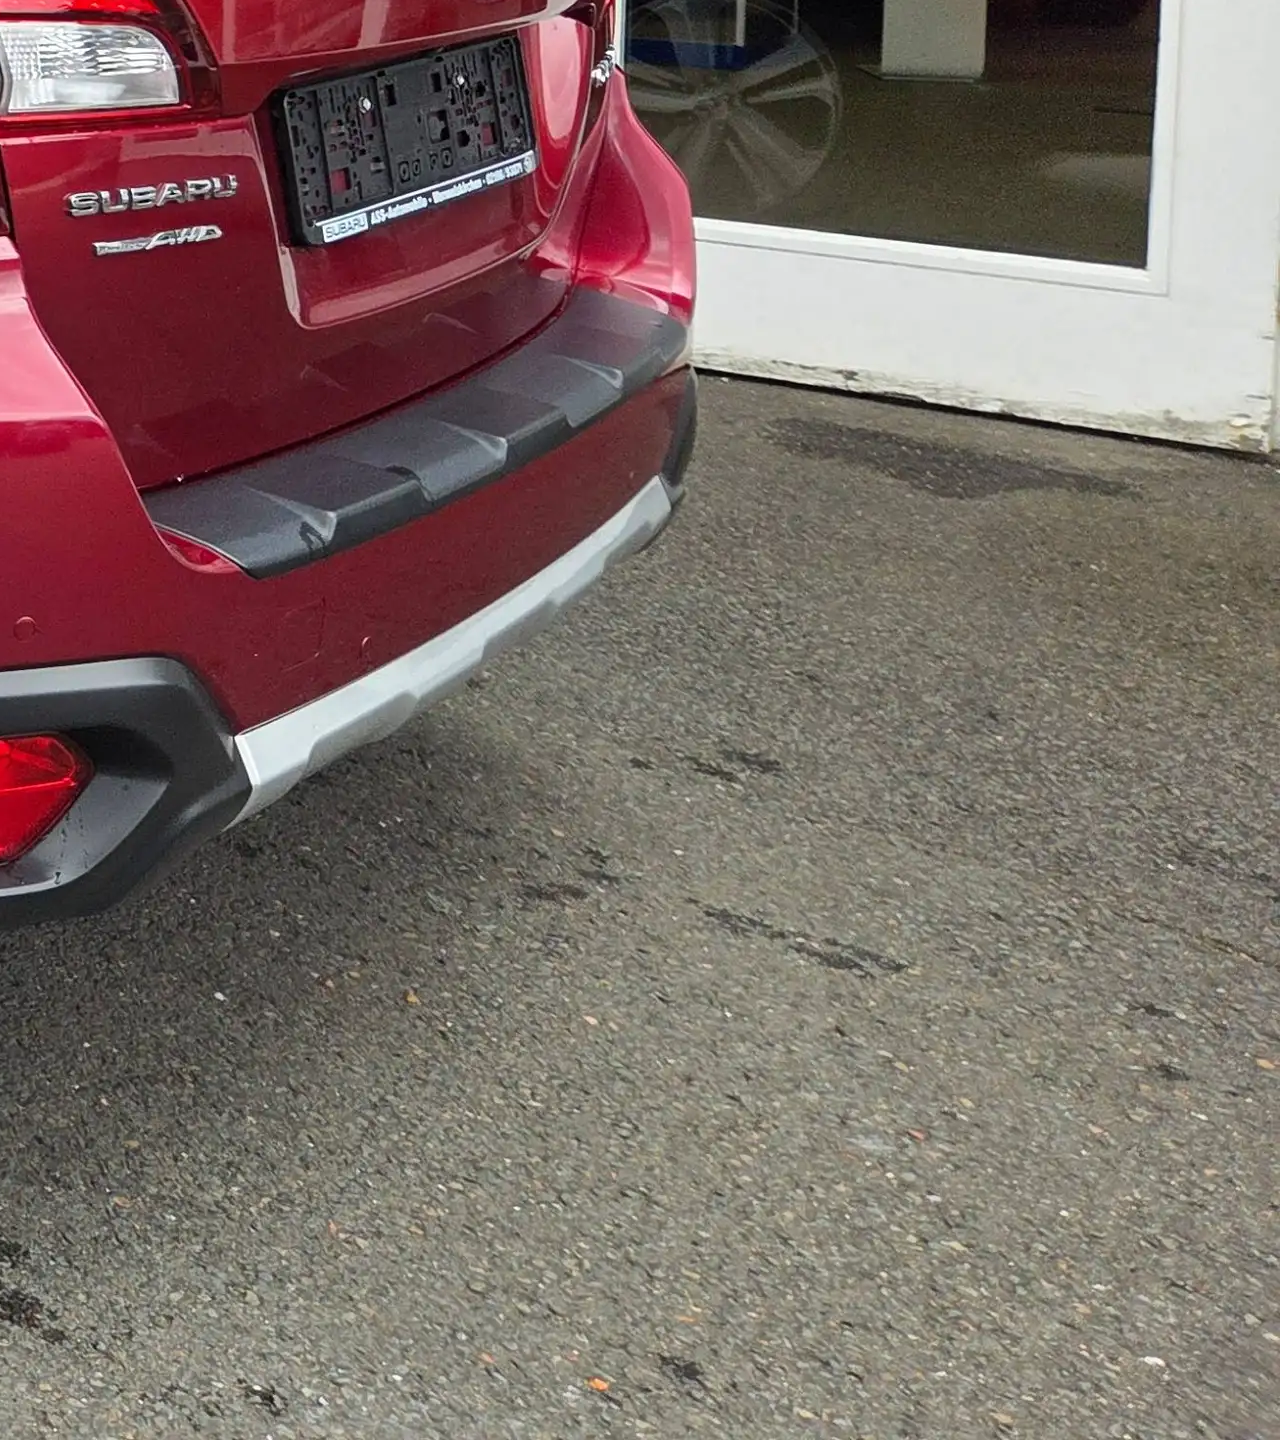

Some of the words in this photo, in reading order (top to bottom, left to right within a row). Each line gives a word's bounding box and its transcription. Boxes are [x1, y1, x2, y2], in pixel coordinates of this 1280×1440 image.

[64, 174, 238, 217] SUBARU
[144, 224, 224, 251] AWD
[324, 213, 368, 240] SUBARU
